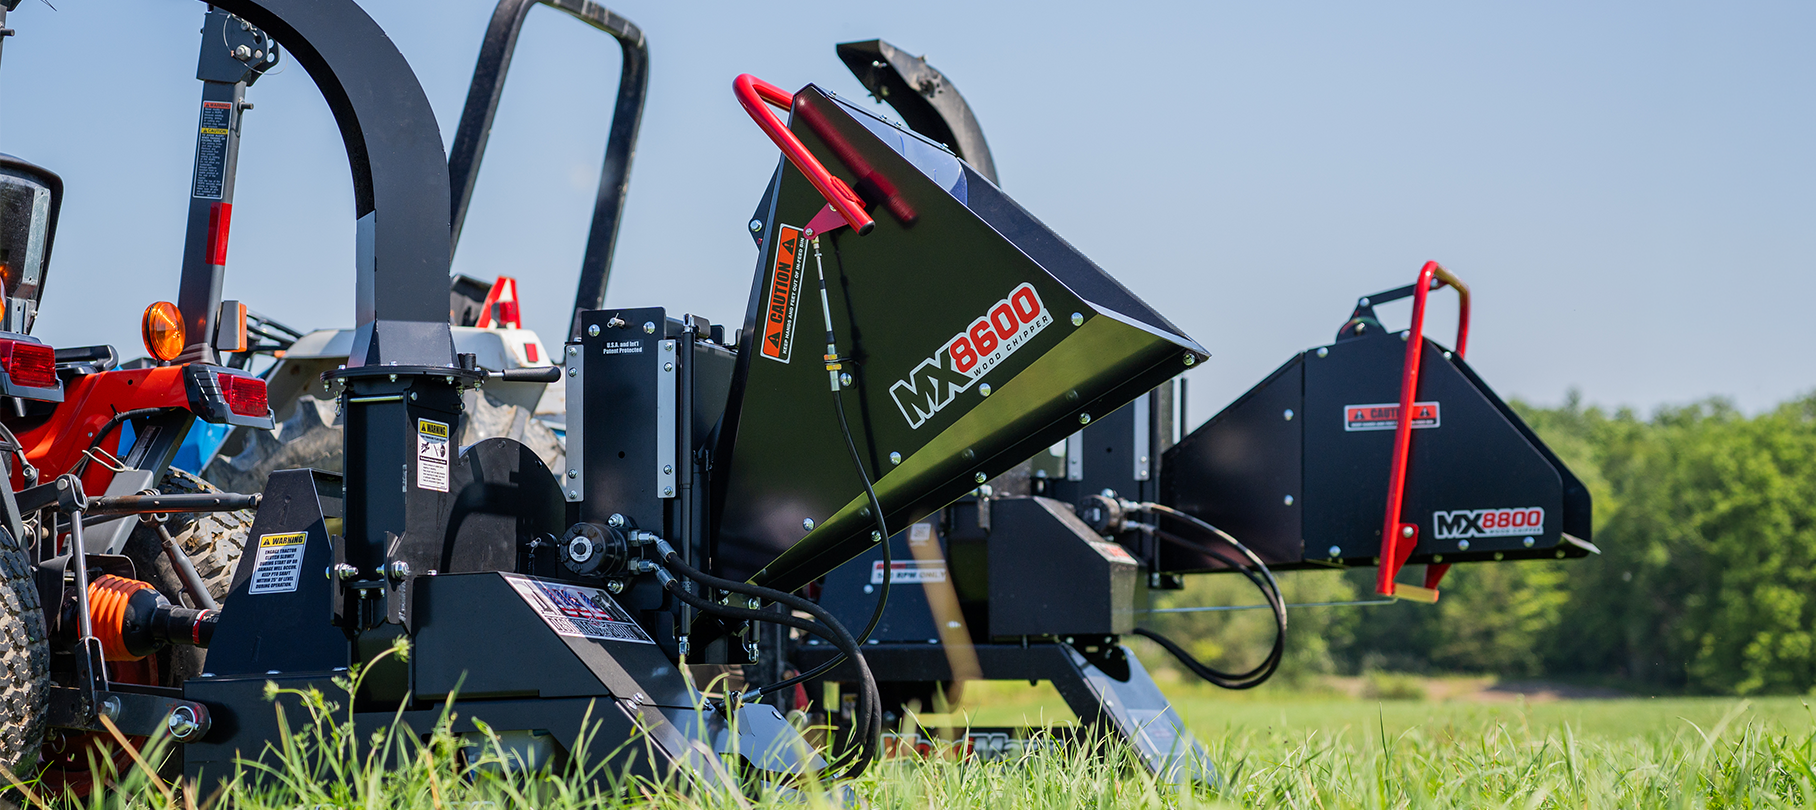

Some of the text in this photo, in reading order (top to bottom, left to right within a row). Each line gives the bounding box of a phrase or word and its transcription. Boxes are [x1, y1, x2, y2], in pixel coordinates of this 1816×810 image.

[795, 271, 800, 279] OF
[770, 262, 791, 324] CAUTION
[891, 285, 1041, 425] MX8600
[974, 315, 1048, 377] WOOD CHIPPER
[1437, 510, 1541, 535] MX8800
[272, 536, 303, 545] WARNING
[542, 587, 614, 622] USA
